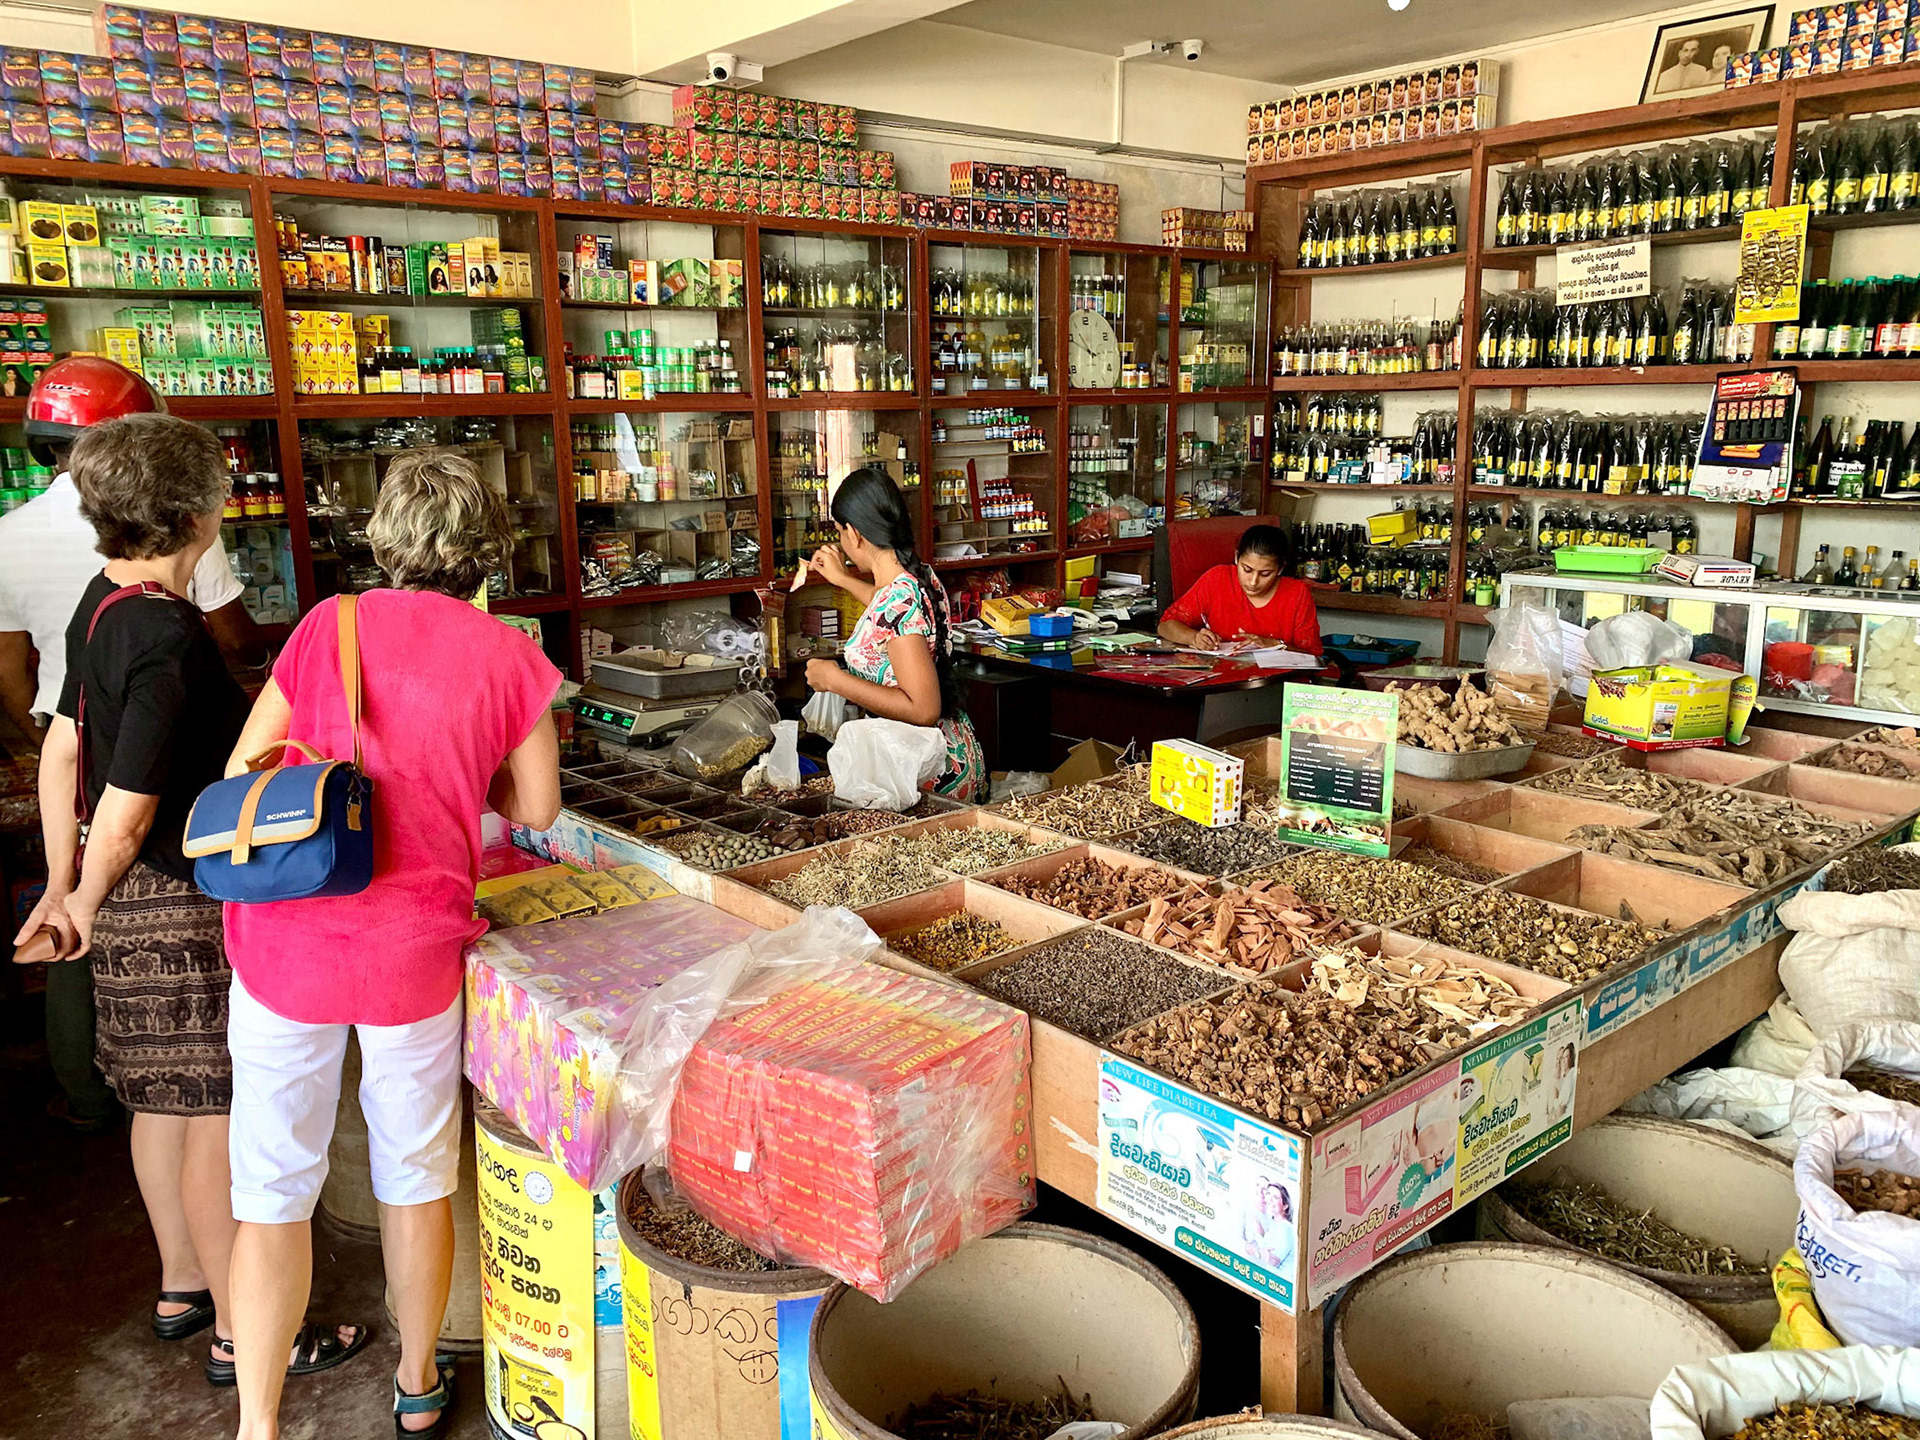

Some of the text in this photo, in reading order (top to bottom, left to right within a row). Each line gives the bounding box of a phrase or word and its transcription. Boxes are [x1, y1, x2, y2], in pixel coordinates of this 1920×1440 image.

[266, 810, 303, 821] SCHWINN
[1465, 1050, 1485, 1070] NEW
[1107, 1061, 1218, 1120] NEW LIFE DIABETEA
[1109, 1132, 1191, 1188] දියවැඩියාව
[1122, 1163, 1148, 1186] අධික
[1150, 1176, 1178, 1201] රුධිර
[1401, 1172, 1421, 1196] 100%
[524, 1212, 538, 1227] 24
[498, 1236, 541, 1275] නිවන
[1177, 1230, 1193, 1246] මෙම
[1233, 1257, 1251, 1280] මිලදී
[1253, 1270, 1267, 1286] ගත
[511, 1274, 561, 1305] පහන
[515, 1312, 551, 1336] 07.00
